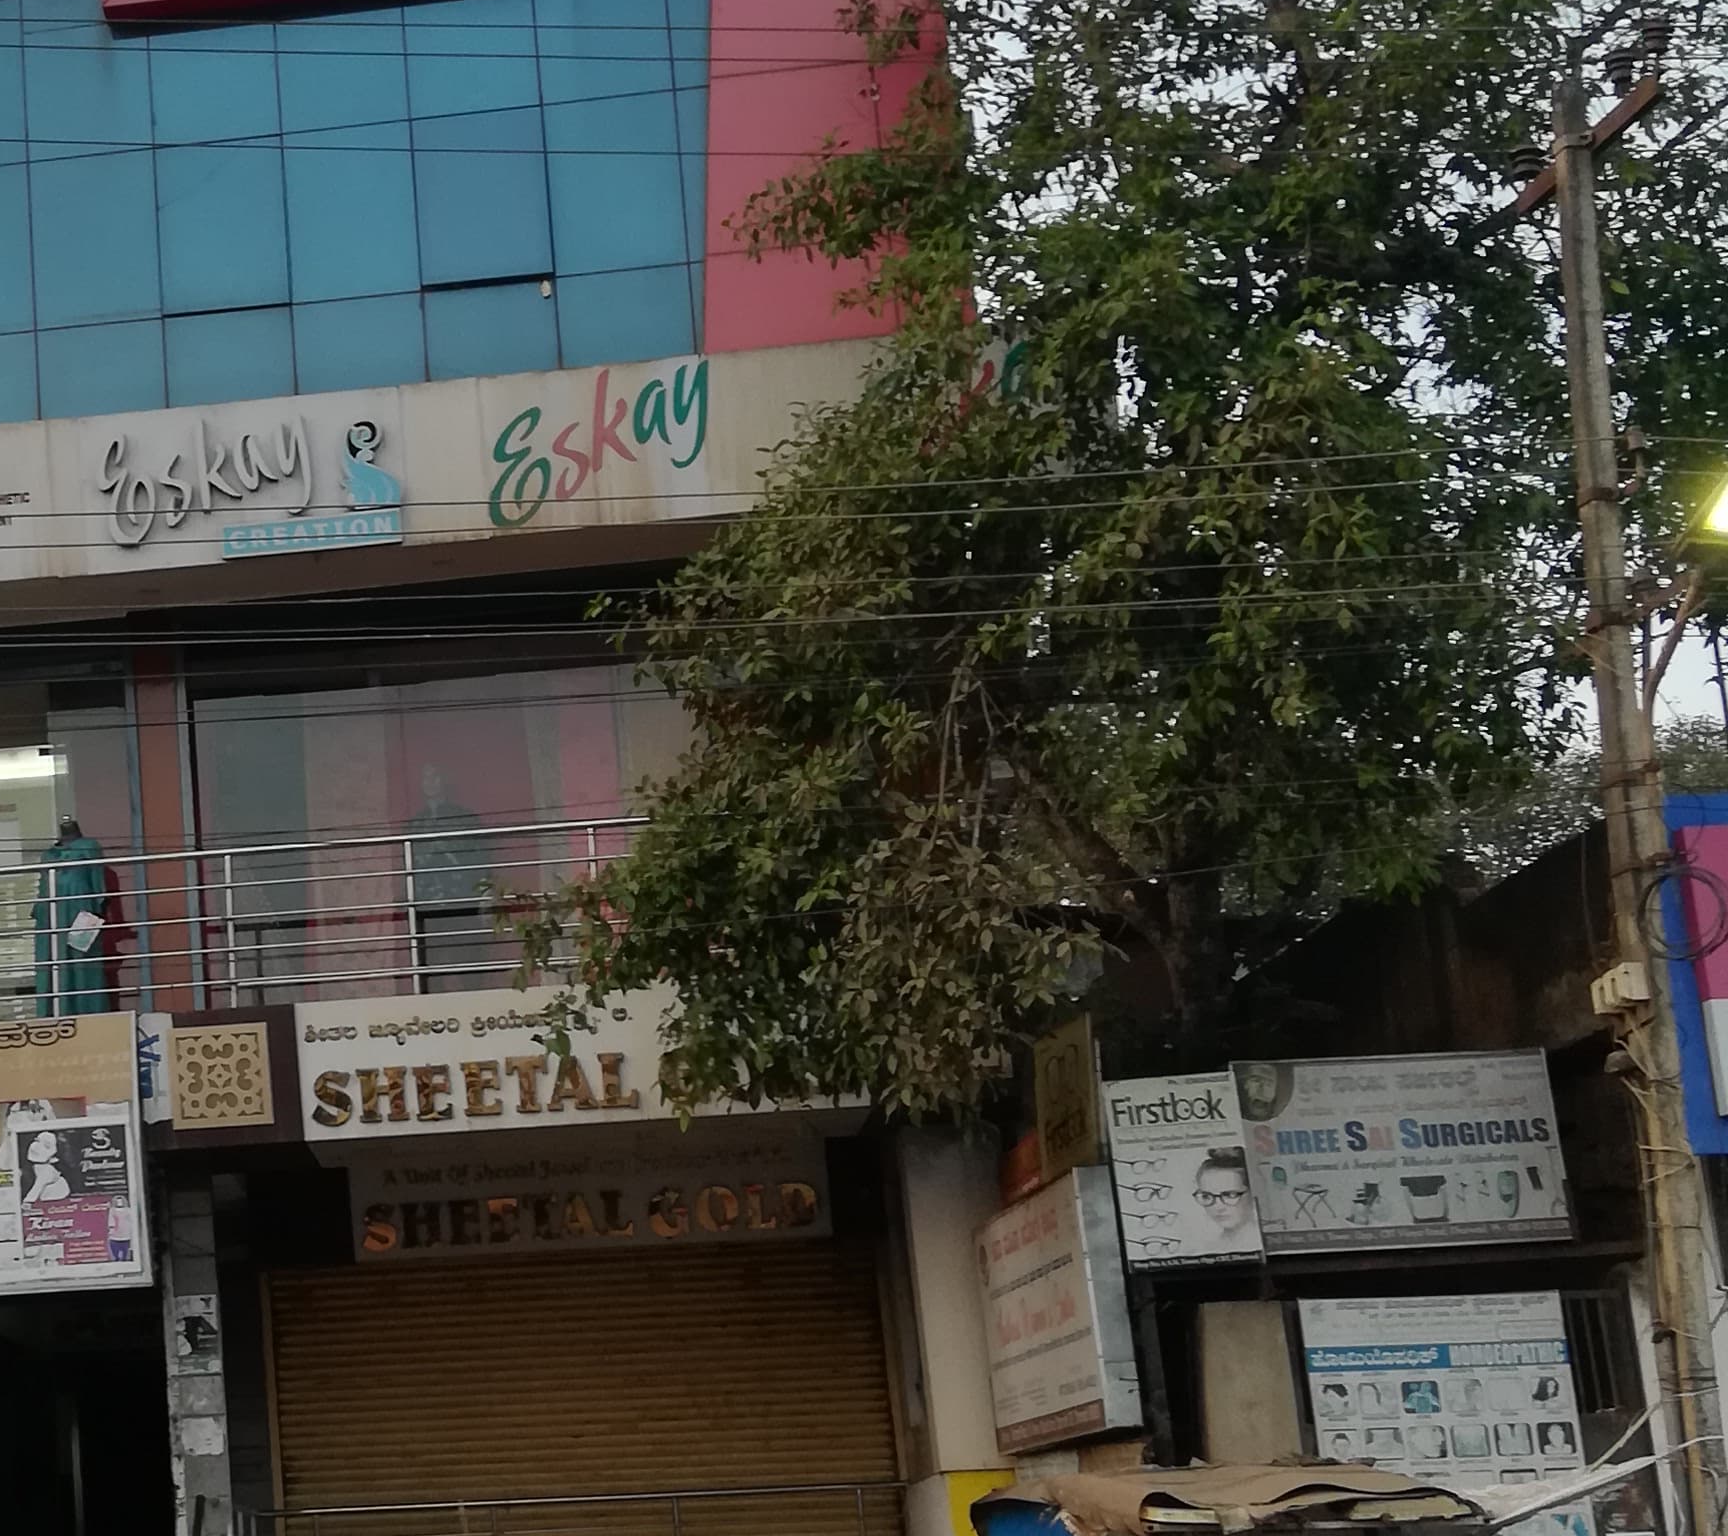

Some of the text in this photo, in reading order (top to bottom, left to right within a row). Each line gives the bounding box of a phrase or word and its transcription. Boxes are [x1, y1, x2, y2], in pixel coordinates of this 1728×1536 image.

[489, 359, 709, 528] Eskay
[97, 415, 311, 547] Eskay
[230, 515, 394, 551] CREATION
[311, 1052, 640, 1127] SHEETAL
[1253, 1124, 1342, 1157] SHREE
[1398, 1117, 1550, 1149] SURGICALS
[363, 1180, 819, 1253] SHEETAL GOLD
